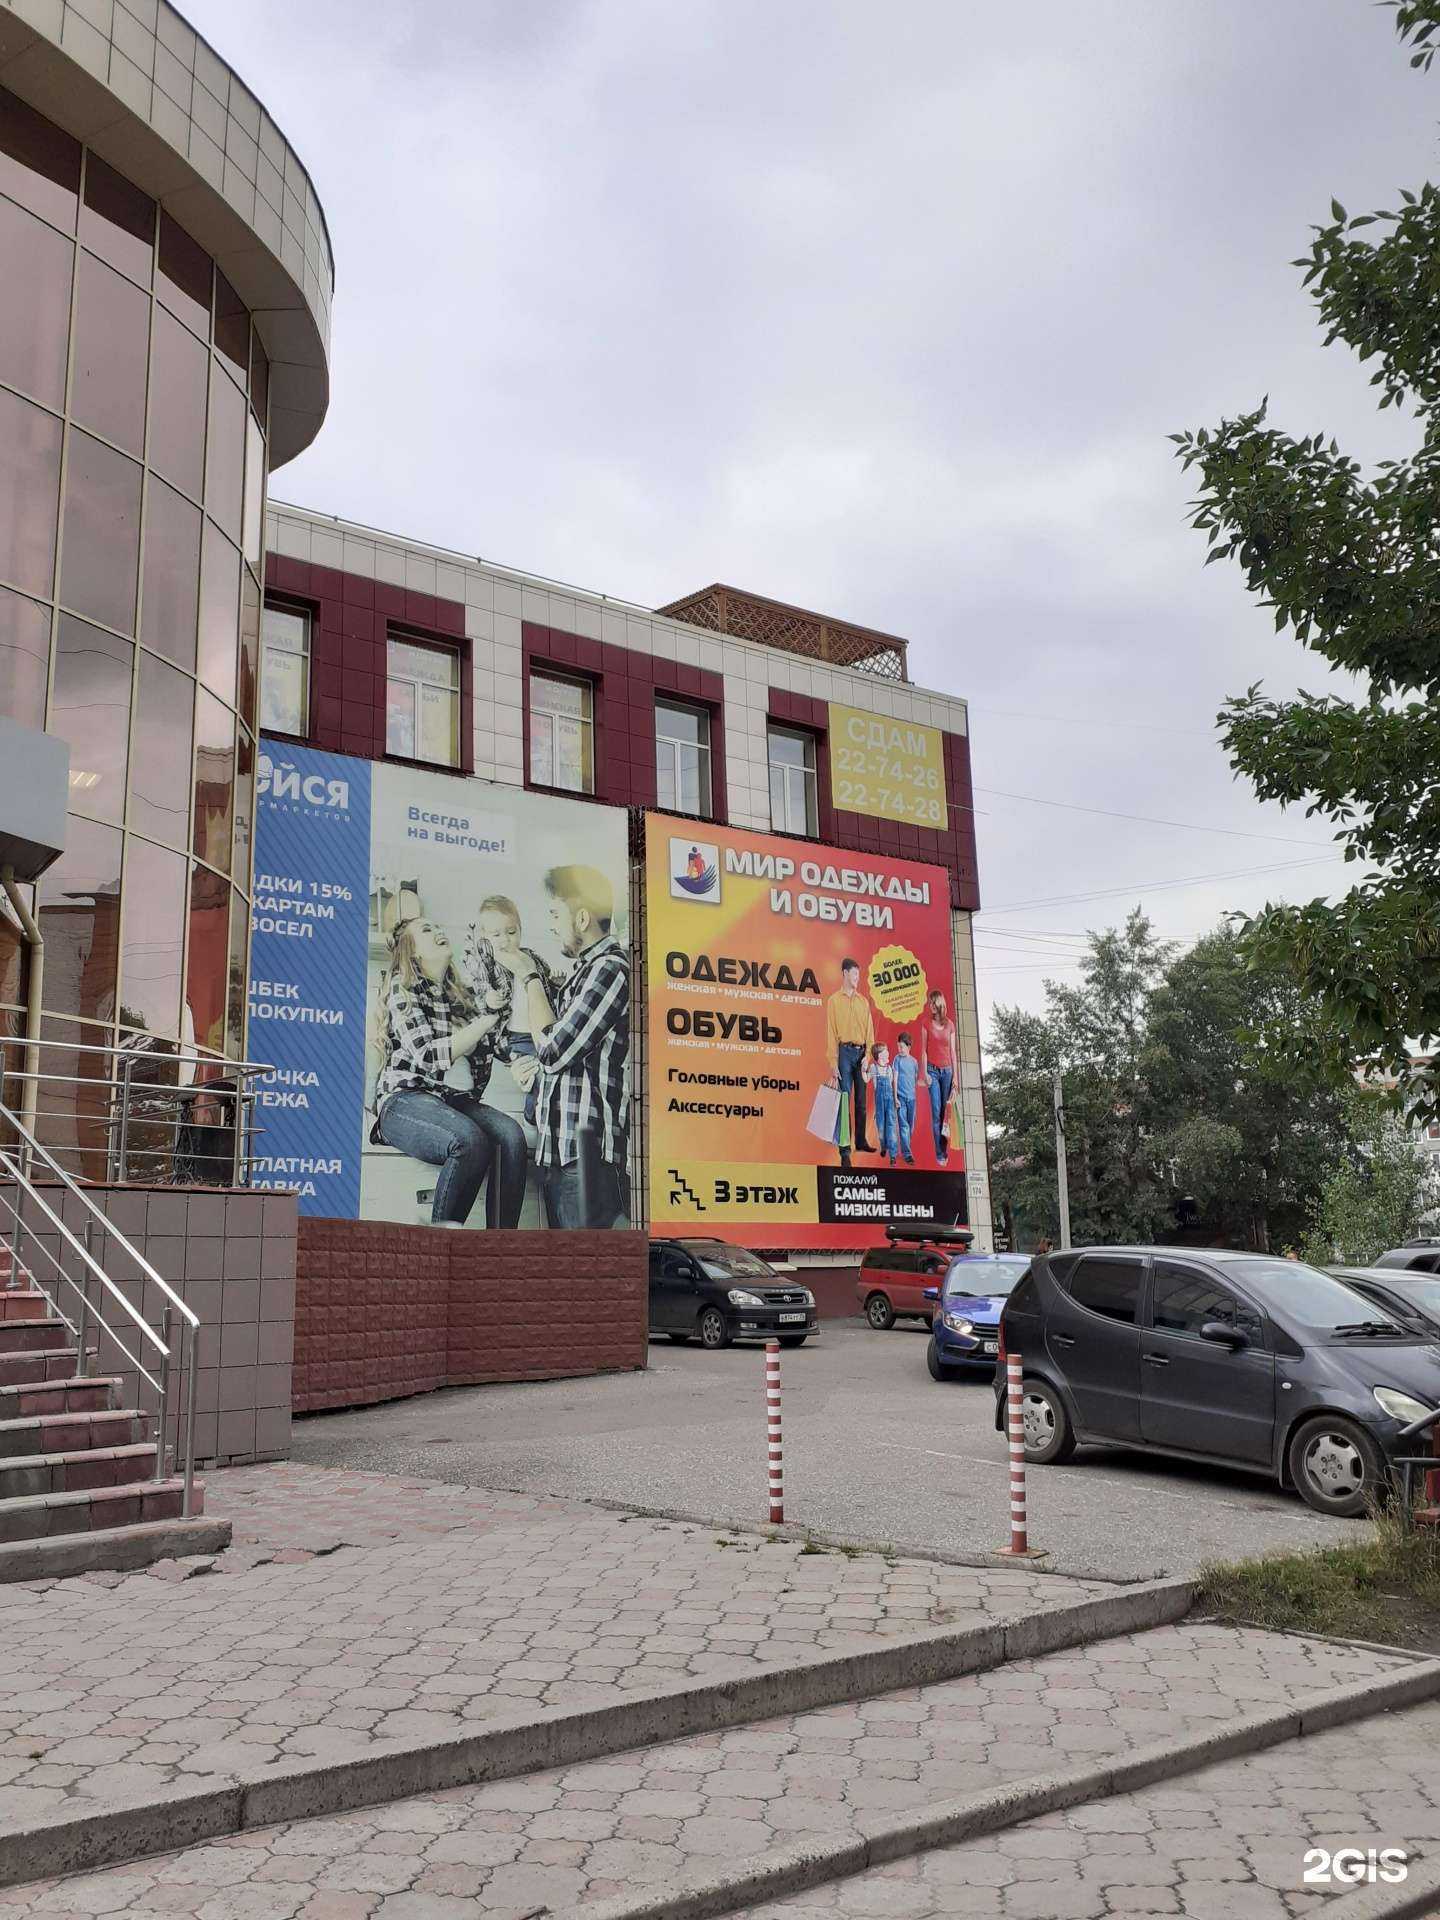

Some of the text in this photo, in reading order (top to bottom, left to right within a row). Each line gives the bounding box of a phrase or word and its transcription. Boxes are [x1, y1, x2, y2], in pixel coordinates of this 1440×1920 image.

[847, 716, 928, 758] СДАМ
[837, 747, 939, 790] 22-74-26
[839, 780, 941, 821] 22-74-28
[408, 806, 470, 830] Всегда
[407, 826, 505, 853] на выгоде!
[253, 873, 352, 901] ДКИ 15%
[725, 847, 930, 905] МИР ОДЕЖДЫ
[770, 888, 894, 930] И ОБУВИ
[666, 951, 821, 994] ОДЕЖДА
[873, 963, 920, 988] 30 000
[724, 988, 774, 1001] мужская
[667, 1007, 782, 1044] ОБУВЬ
[668, 1068, 800, 1093] Головные уборы
[668, 1098, 764, 1119] Аксессуары
[715, 1180, 799, 1204] 3 этаж
[834, 1175, 878, 1185] ПОЖАЛУЙ
[834, 1187, 886, 1201] САМЫЕ
[835, 1203, 935, 1218] НИЗКИЕ ЦЕНЫ
